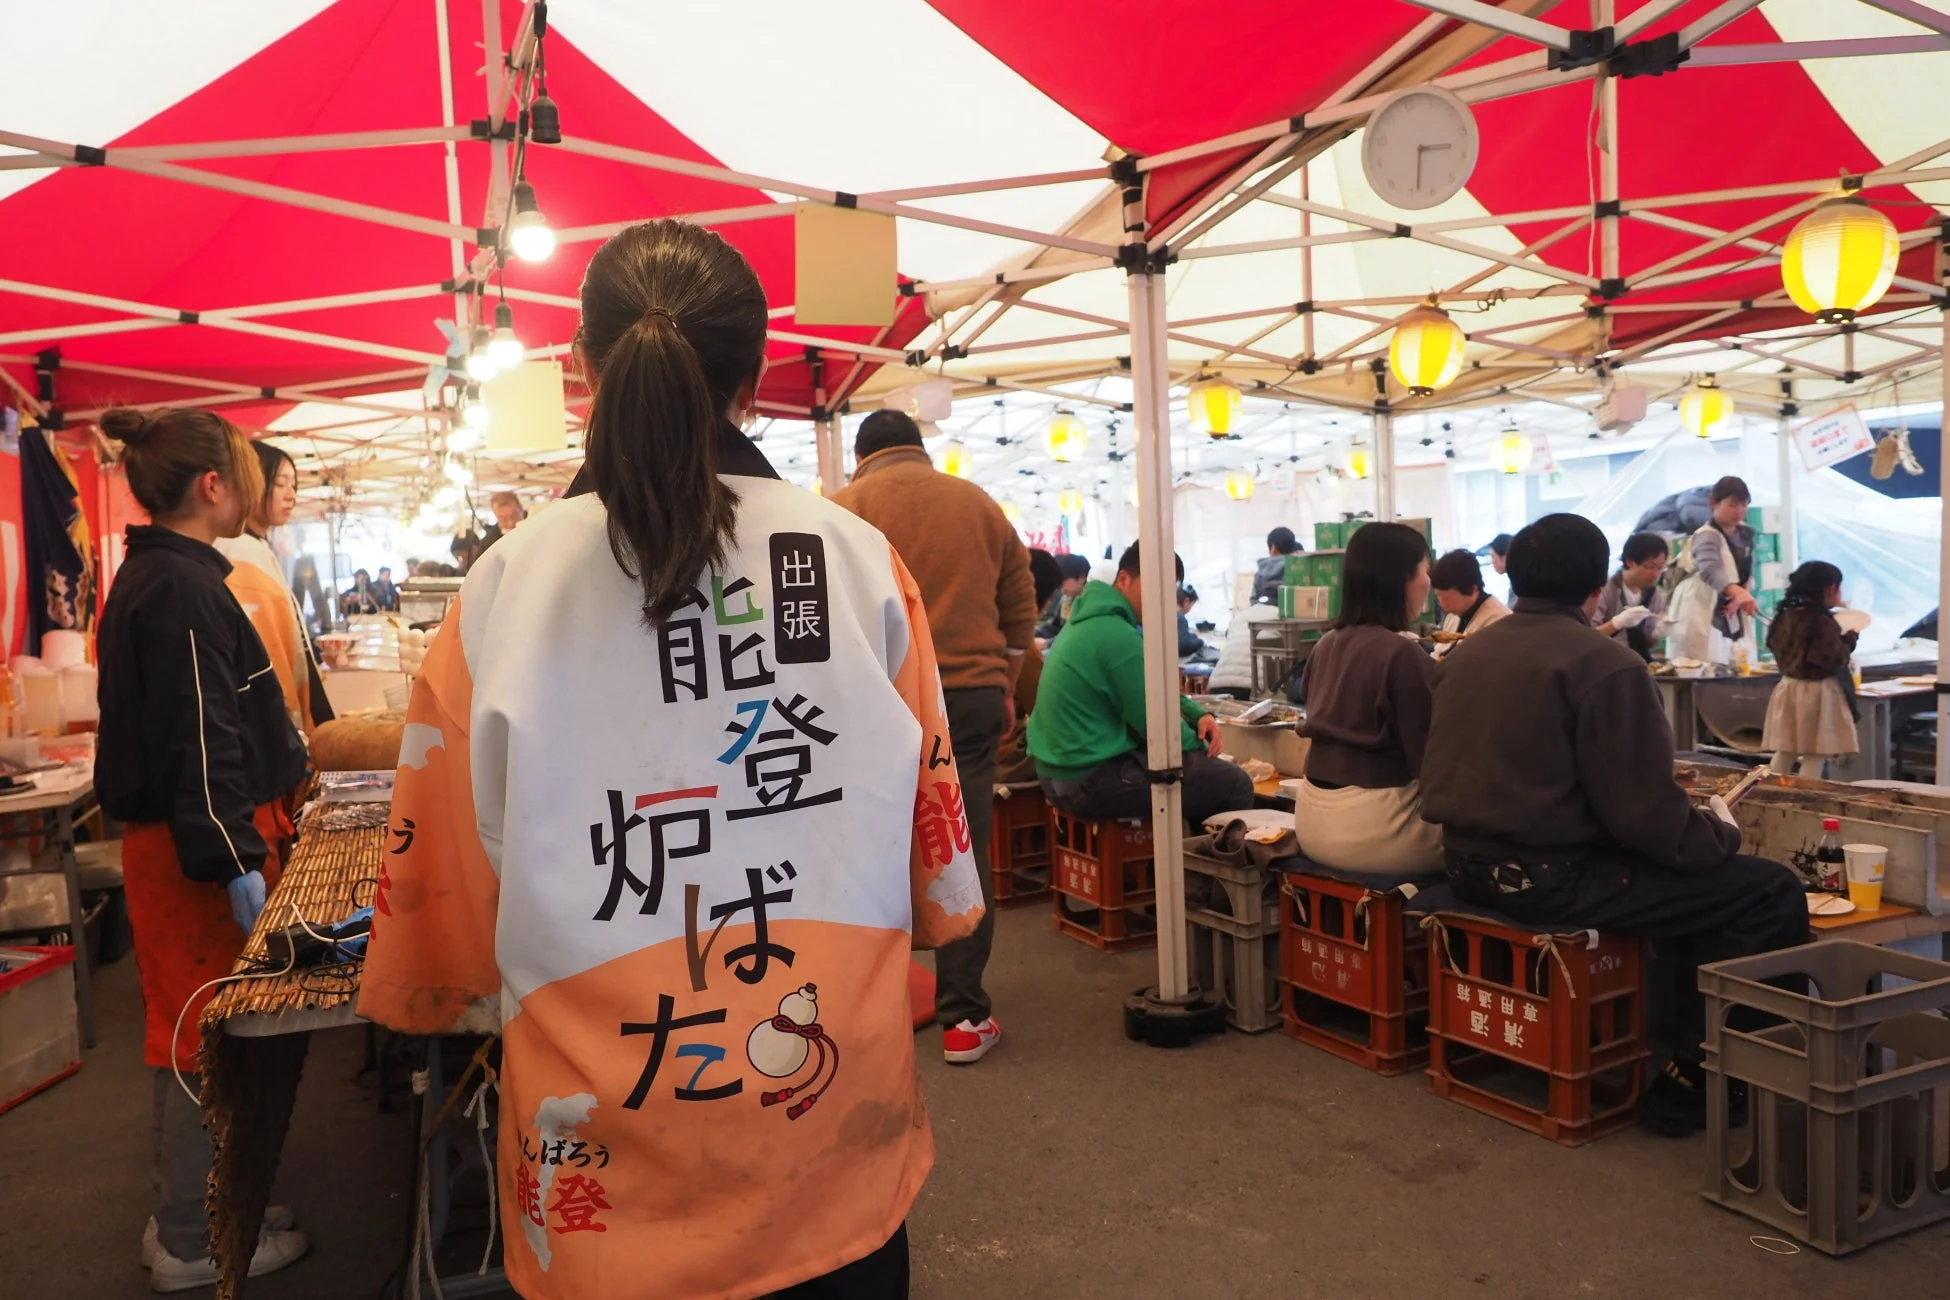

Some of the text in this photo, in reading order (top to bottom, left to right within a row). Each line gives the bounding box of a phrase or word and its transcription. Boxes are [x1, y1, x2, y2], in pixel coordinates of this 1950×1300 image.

[780, 549, 822, 640] 出張
[1457, 984, 1538, 1022] 専用通箱
[1470, 1010, 1524, 1048] 清酒
[516, 1164, 613, 1234] 能登
